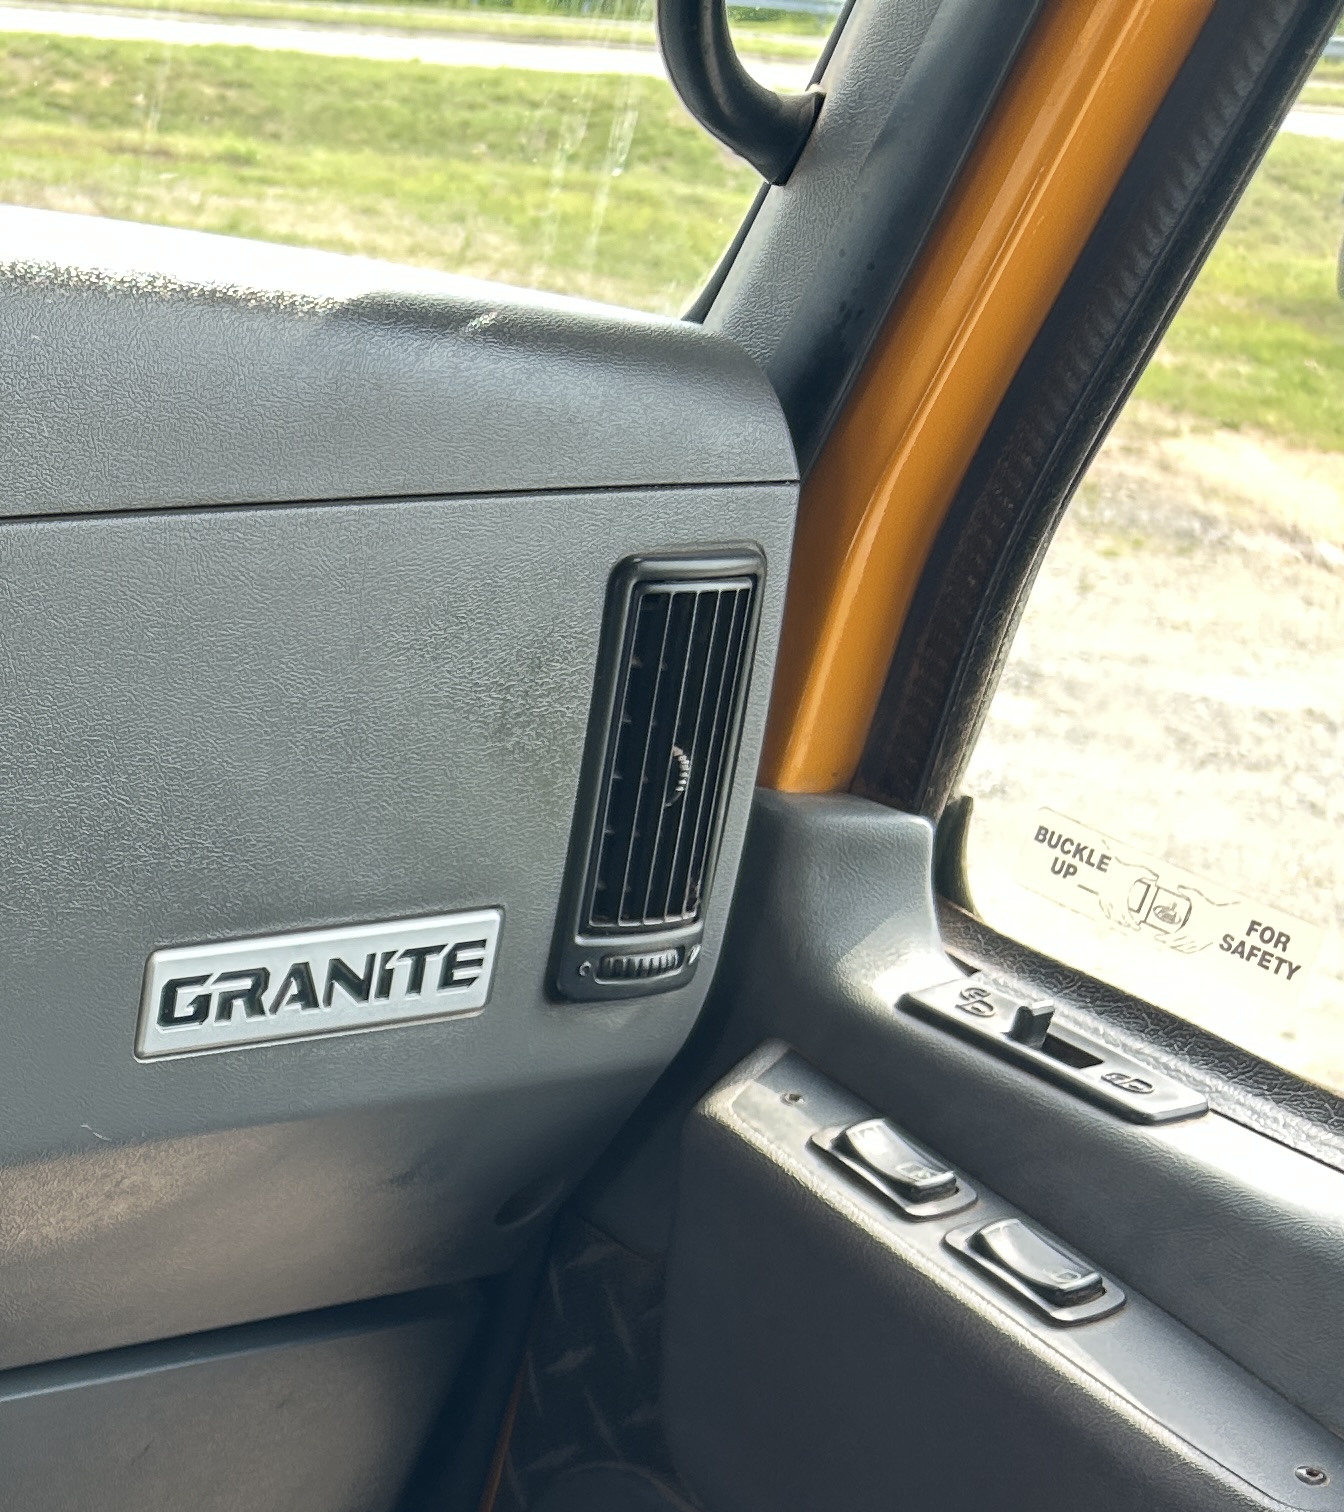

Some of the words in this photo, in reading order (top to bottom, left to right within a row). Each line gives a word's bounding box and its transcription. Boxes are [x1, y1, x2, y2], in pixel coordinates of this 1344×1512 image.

[1033, 824, 1112, 874] BUCKLE
[1050, 856, 1078, 881] UP
[1218, 933, 1302, 982] SAFETY
[1245, 919, 1292, 953] FOR
[156, 938, 488, 1030] GRANITE
